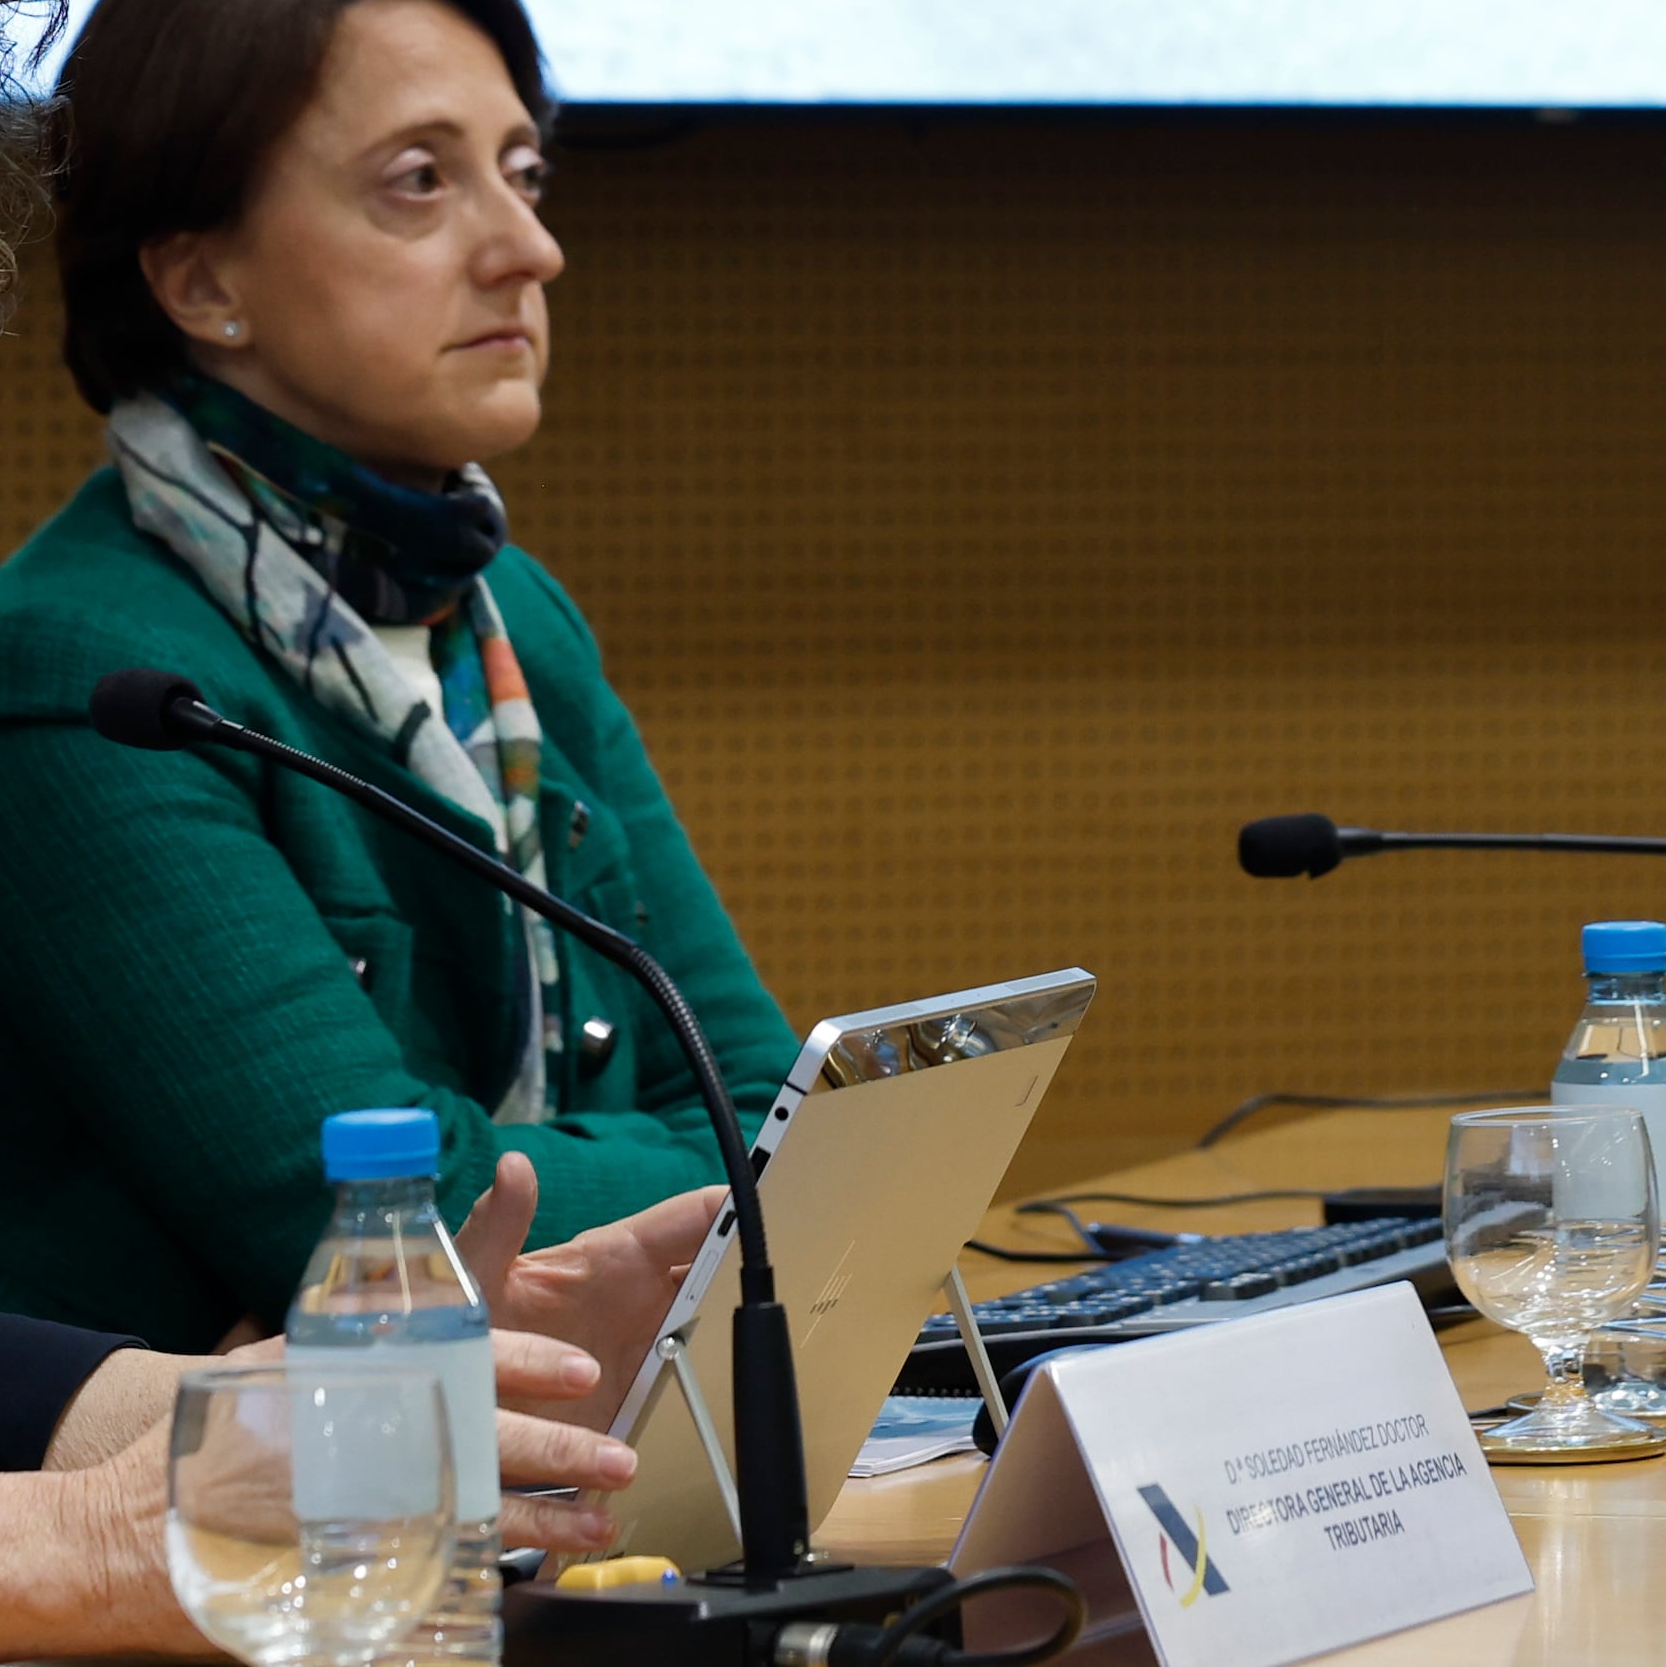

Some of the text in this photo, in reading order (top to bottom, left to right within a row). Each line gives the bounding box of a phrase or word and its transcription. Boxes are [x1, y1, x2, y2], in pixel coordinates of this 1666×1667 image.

[1244, 1443, 1305, 1480] SOLEDAD
[1304, 1426, 1380, 1466] FERNÁNDEZ
[1378, 1414, 1429, 1447] DOCTOR
[1306, 1477, 1373, 1514] GENERAL
[1369, 1471, 1392, 1497] DE
[1388, 1467, 1411, 1492] LA
[1409, 1451, 1468, 1488] AGENCIA
[1324, 1509, 1406, 1551] TRIBUTARIA
